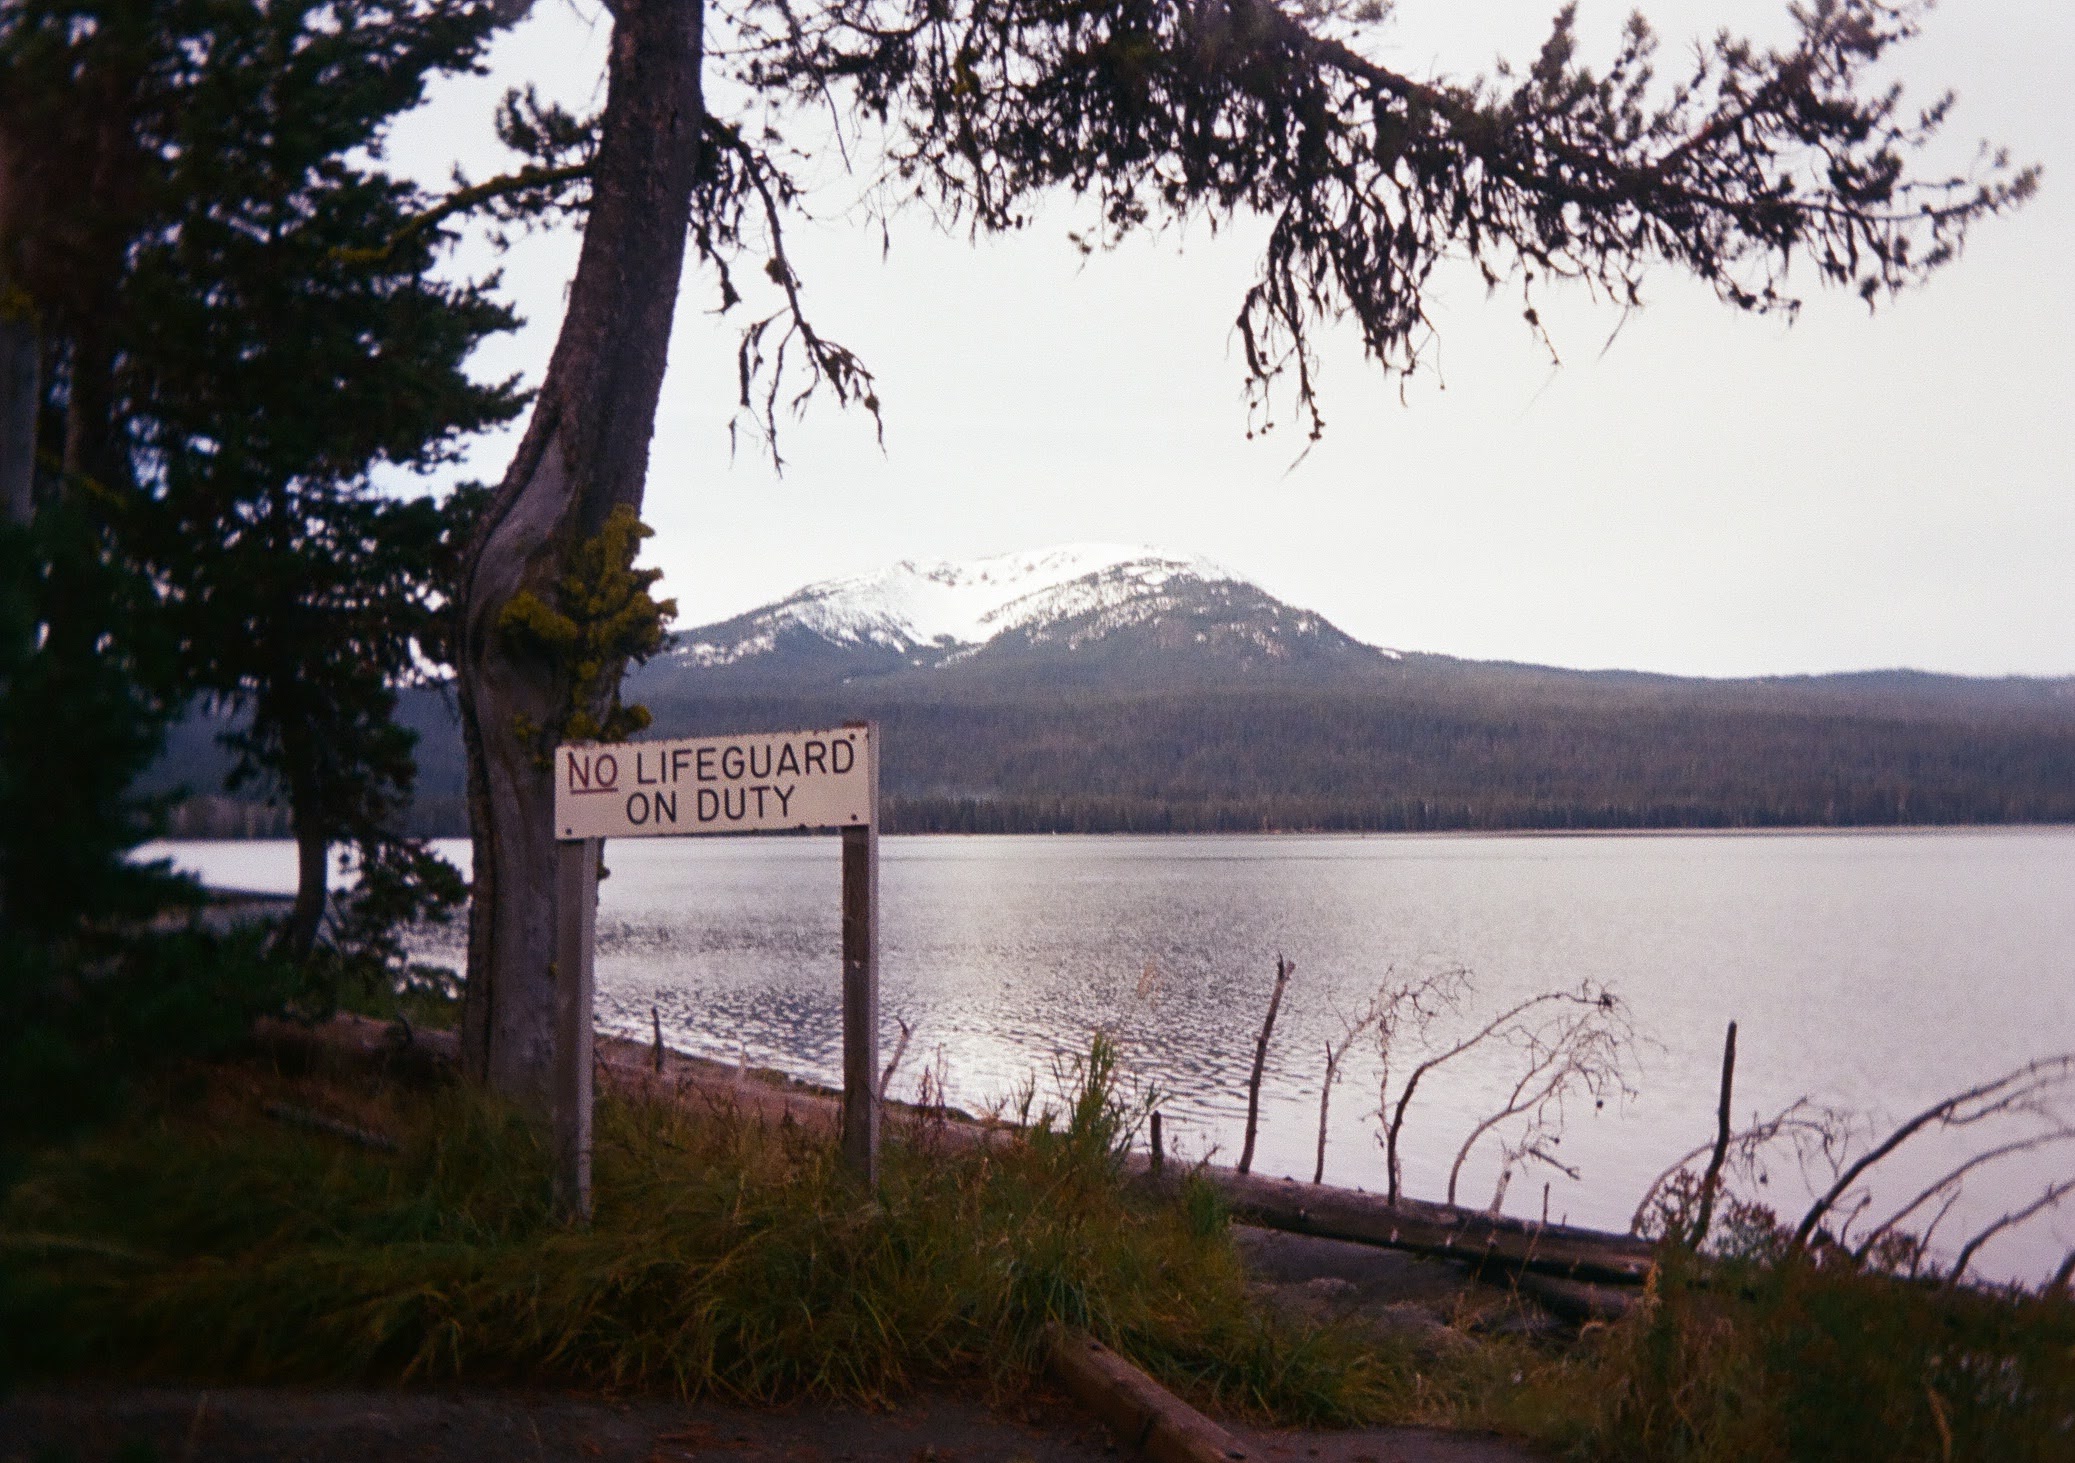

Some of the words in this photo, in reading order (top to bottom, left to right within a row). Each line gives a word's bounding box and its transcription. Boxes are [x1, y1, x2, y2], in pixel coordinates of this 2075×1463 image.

[568, 751, 618, 788] NO
[637, 739, 854, 784] LIFEGUARD
[626, 791, 676, 825] ON
[698, 785, 795, 822] DUTY
